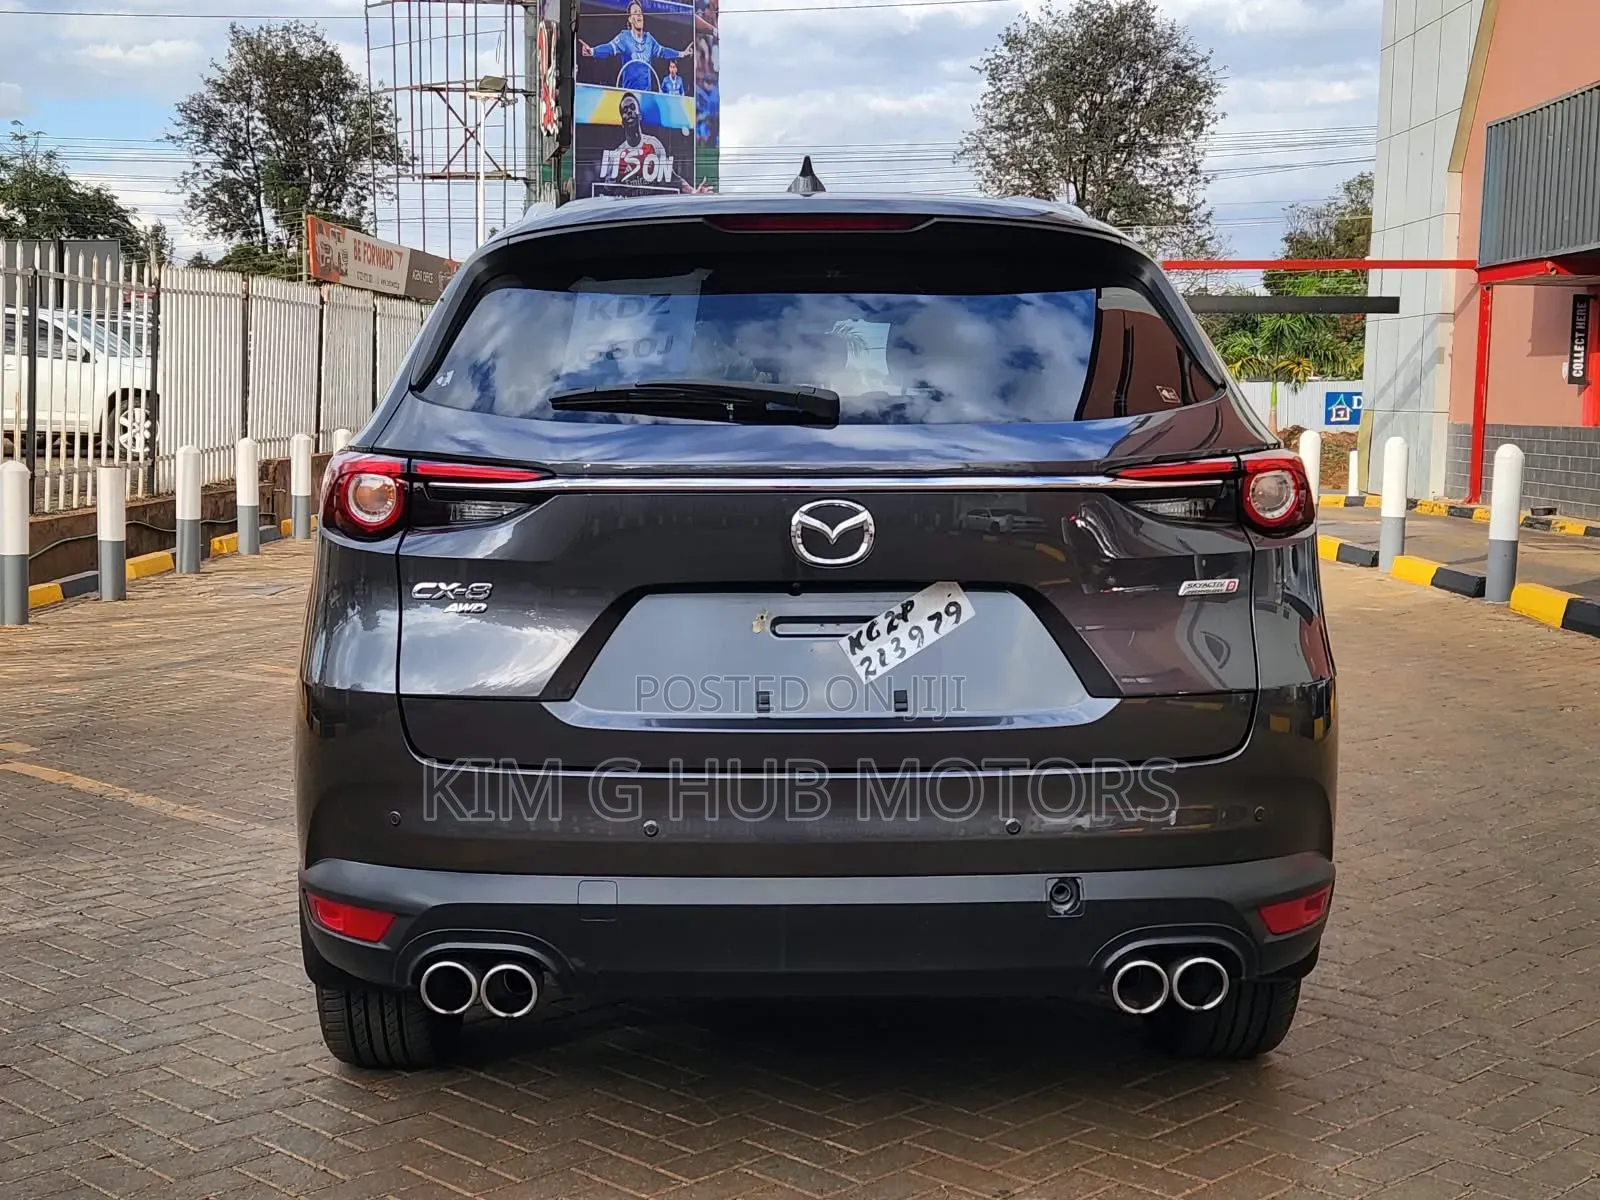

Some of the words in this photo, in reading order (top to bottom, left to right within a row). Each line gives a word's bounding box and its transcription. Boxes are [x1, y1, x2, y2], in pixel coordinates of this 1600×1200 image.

[600, 150, 643, 182] IT'S
[643, 154, 674, 183] ON
[354, 238, 361, 262] BE
[363, 241, 394, 270] FORWARD
[586, 293, 672, 320] KDZ
[1576, 301, 1587, 330] HERE
[1572, 332, 1585, 378] COLLECT
[411, 582, 493, 600] CX-8
[443, 602, 488, 613] AWD
